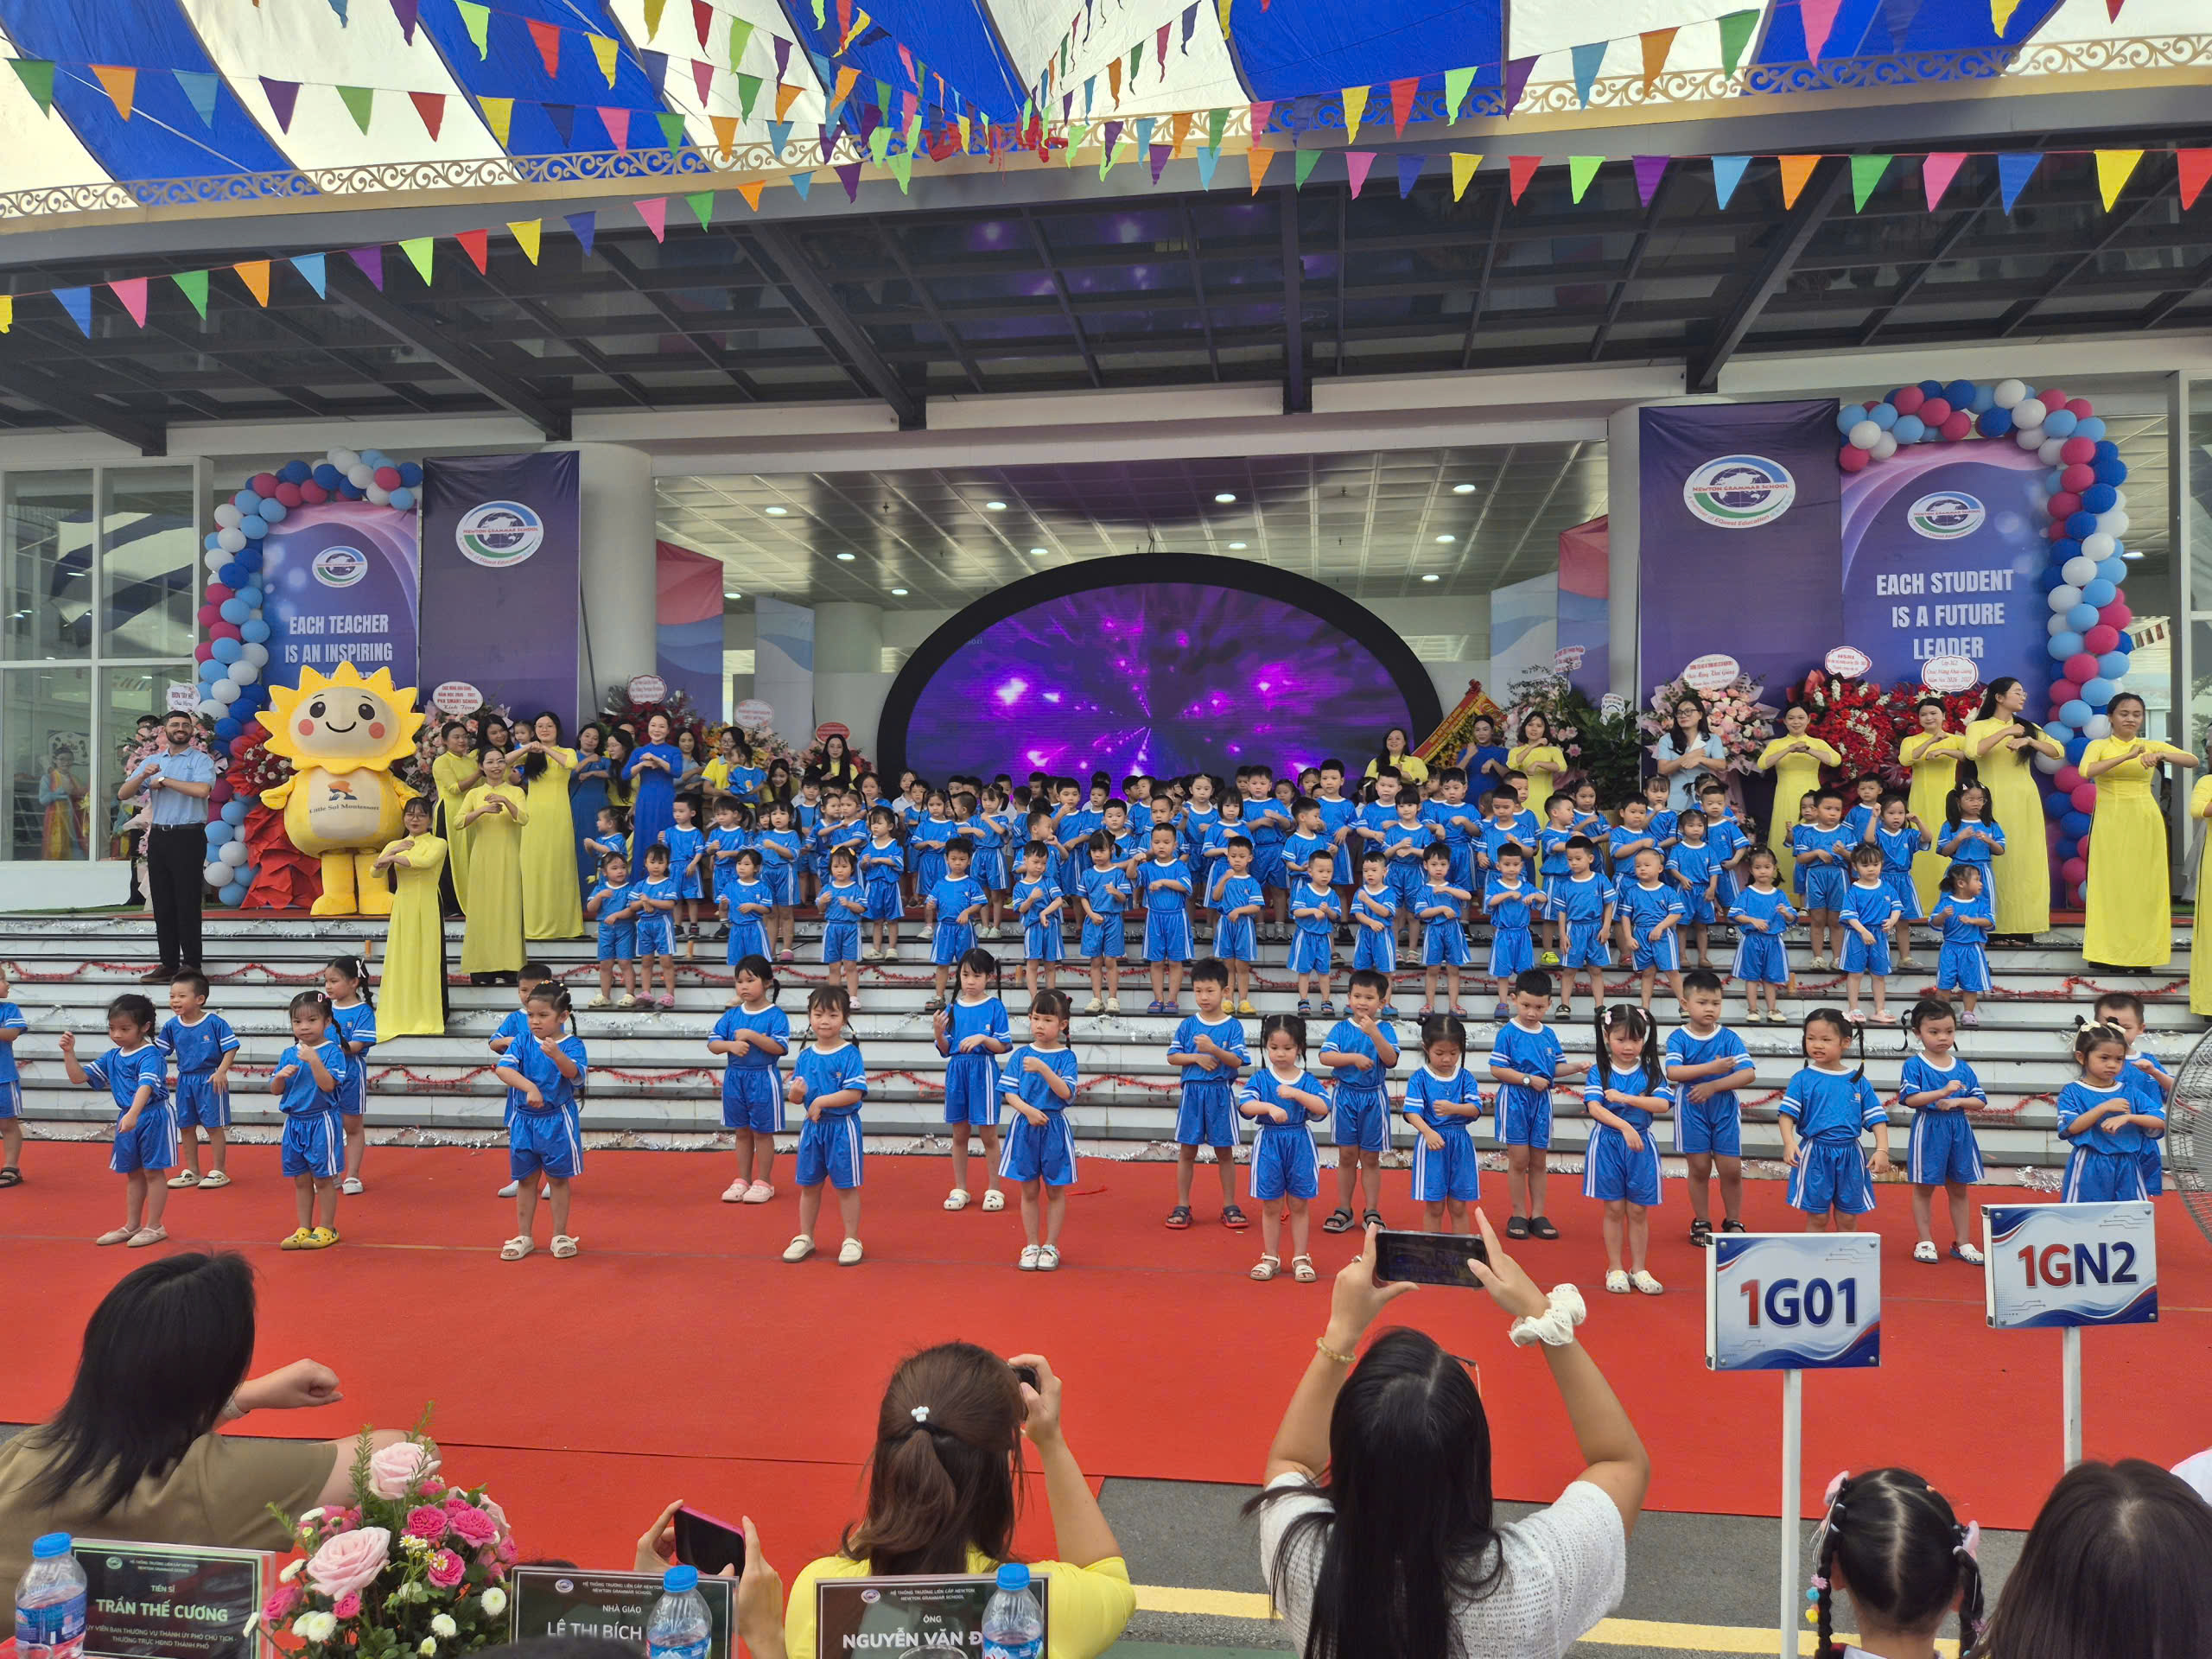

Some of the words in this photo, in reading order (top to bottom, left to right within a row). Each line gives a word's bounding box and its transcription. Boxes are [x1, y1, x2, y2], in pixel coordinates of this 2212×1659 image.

[1738, 515, 1769, 526] Education
[1876, 573, 1924, 595] EACH
[1930, 569, 2013, 594] STUDENT
[289, 615, 325, 635] EACH
[329, 614, 388, 634] TEACHER
[1892, 606, 1910, 627] IS
[1916, 606, 1929, 627] A
[1935, 603, 2005, 626] FUTURE
[285, 645, 298, 663] IS
[302, 644, 321, 663] AN
[325, 643, 393, 663] INSPIRING
[1913, 637, 1984, 659] LEADER
[2018, 1242, 2139, 1287] 1GN2
[1739, 1277, 1858, 1328] 1G01
[151, 1584, 167, 1592] TIẾN
[96, 1596, 136, 1614] TRẦN
[140, 1599, 171, 1618] THẾ
[174, 1605, 228, 1622] CƯƠNG
[602, 1604, 620, 1612] NHÀ
[622, 1604, 641, 1613] GIÁO
[923, 1614, 942, 1624] ÔNG
[547, 1618, 566, 1637] LÊ
[602, 1621, 642, 1640] BÍCH
[842, 1626, 919, 1649] NGUYỄN
[923, 1628, 963, 1646] VĂN
[968, 1631, 982, 1645] Đ
